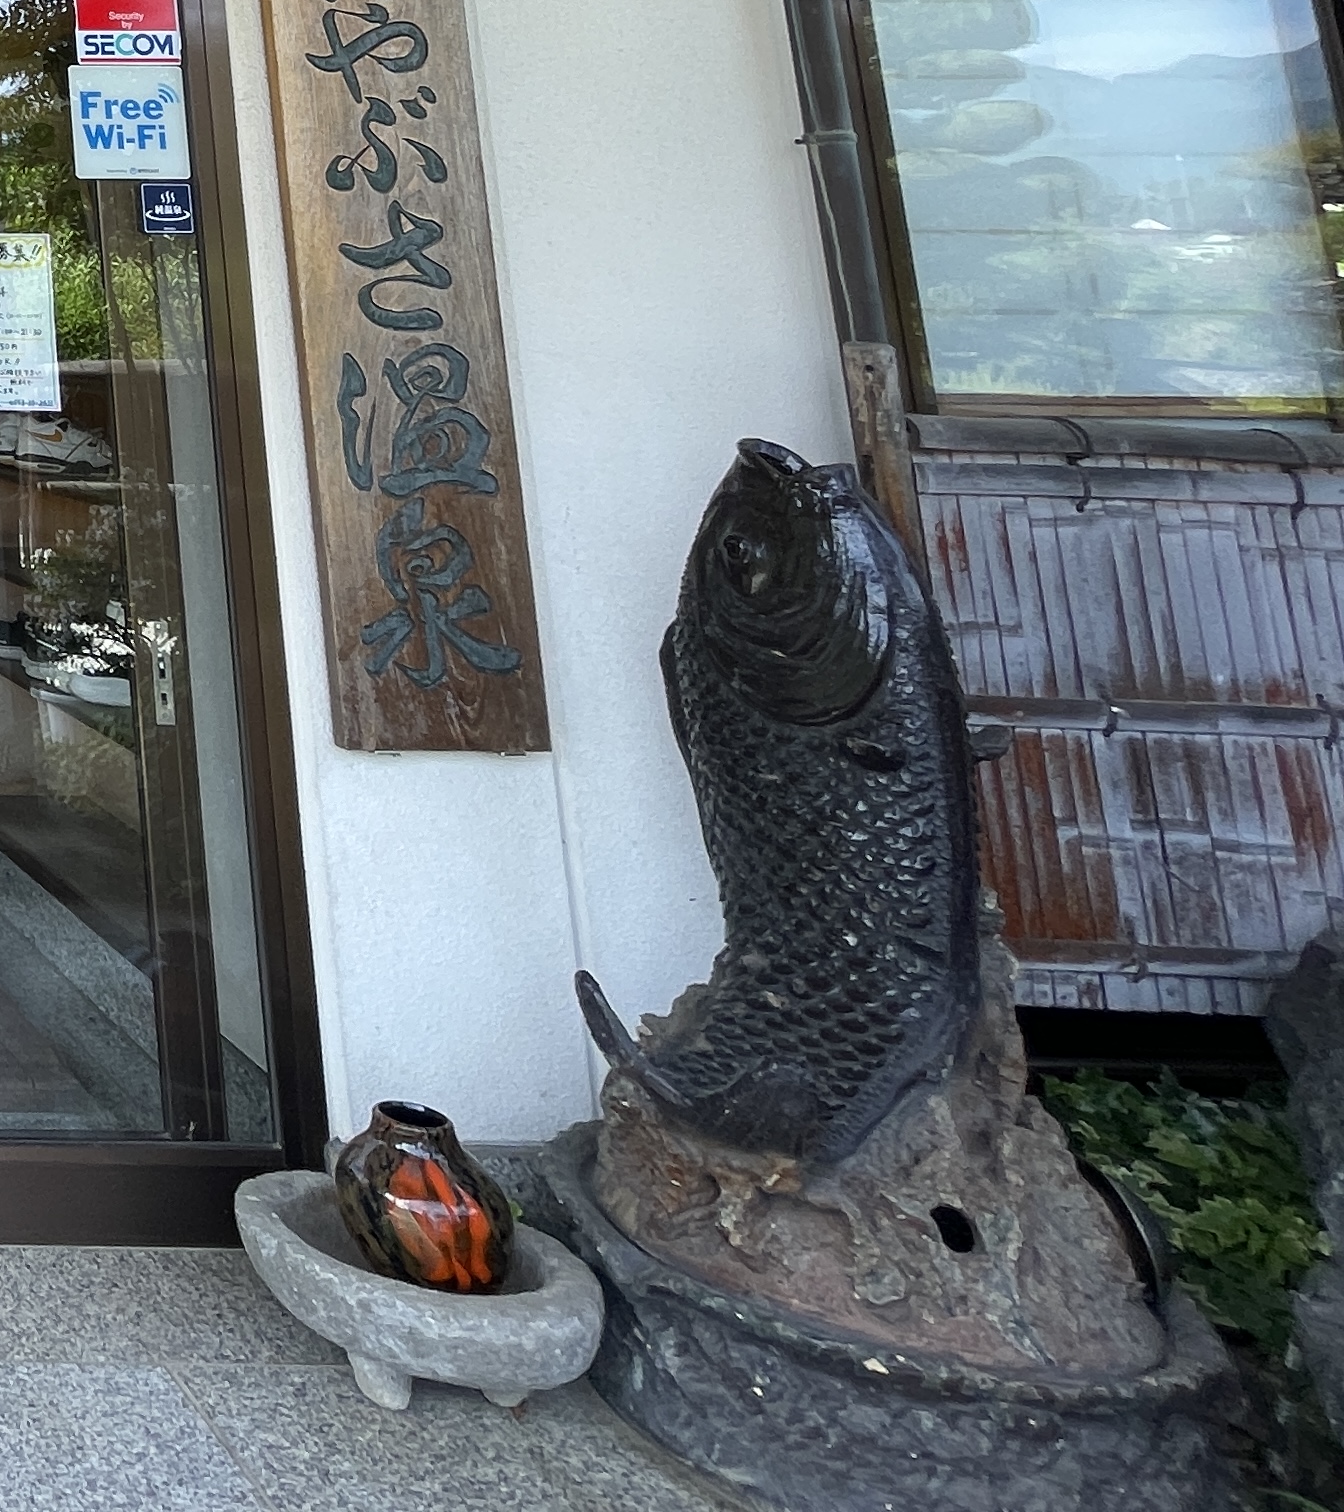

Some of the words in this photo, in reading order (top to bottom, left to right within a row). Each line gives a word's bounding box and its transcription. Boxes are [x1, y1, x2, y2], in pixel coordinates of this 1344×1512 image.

[108, 11, 144, 22] Security
[121, 21, 132, 29] by
[84, 33, 174, 56] SECOM
[79, 90, 164, 120] Free
[82, 124, 167, 150] Wi-Fi
